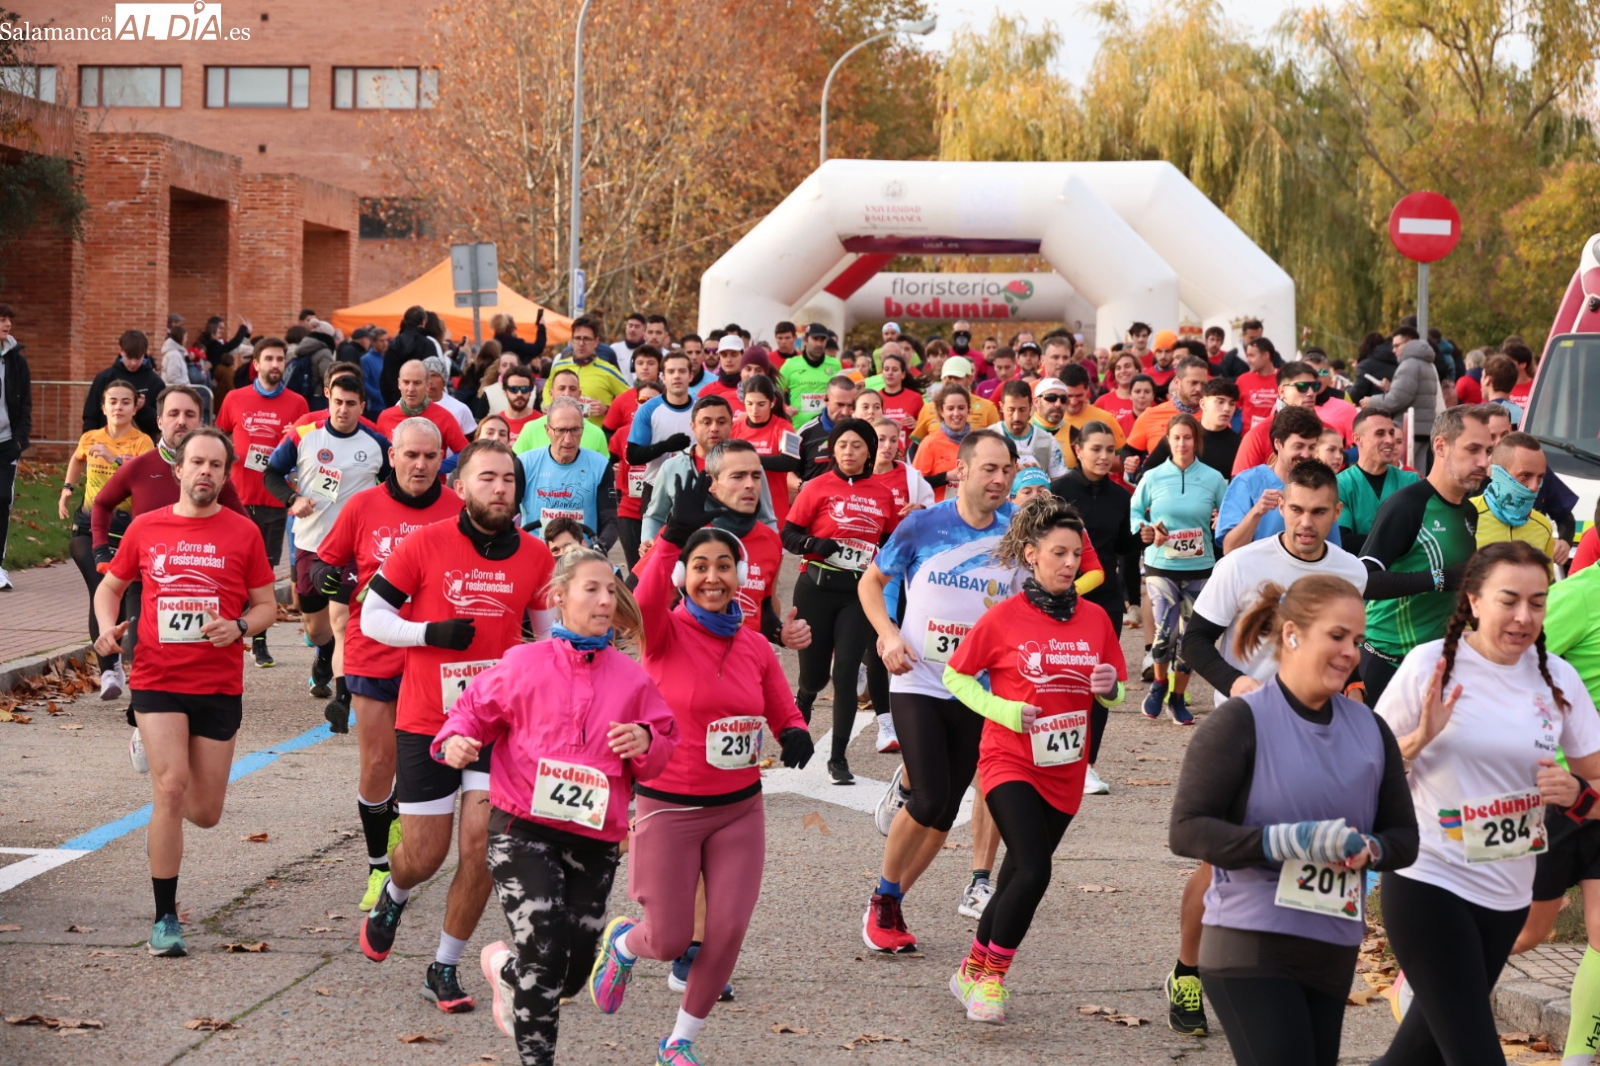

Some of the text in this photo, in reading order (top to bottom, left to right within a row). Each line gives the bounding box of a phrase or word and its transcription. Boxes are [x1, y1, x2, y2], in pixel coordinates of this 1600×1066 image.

[892, 278, 1001, 296] floristería
[884, 297, 1010, 318] bedunia
[810, 400, 820, 408] 49
[255, 454, 269, 465] 95
[177, 540, 216, 554] ¡Corre sin
[1173, 539, 1196, 551] 454
[169, 553, 225, 569] resistencias!
[838, 546, 862, 562] 131
[494, 571, 505, 581] sin
[466, 581, 513, 594] resistencias!
[169, 613, 204, 631] 471
[1076, 639, 1090, 651] sin
[1046, 652, 1099, 666] resistencias!
[721, 733, 751, 756] 239
[1047, 730, 1080, 752] 412
[540, 762, 608, 790] bedunia
[550, 783, 594, 811] 424
[1463, 793, 1541, 821] bedunia
[1482, 815, 1531, 847] 284
[1299, 864, 1348, 898] 201
